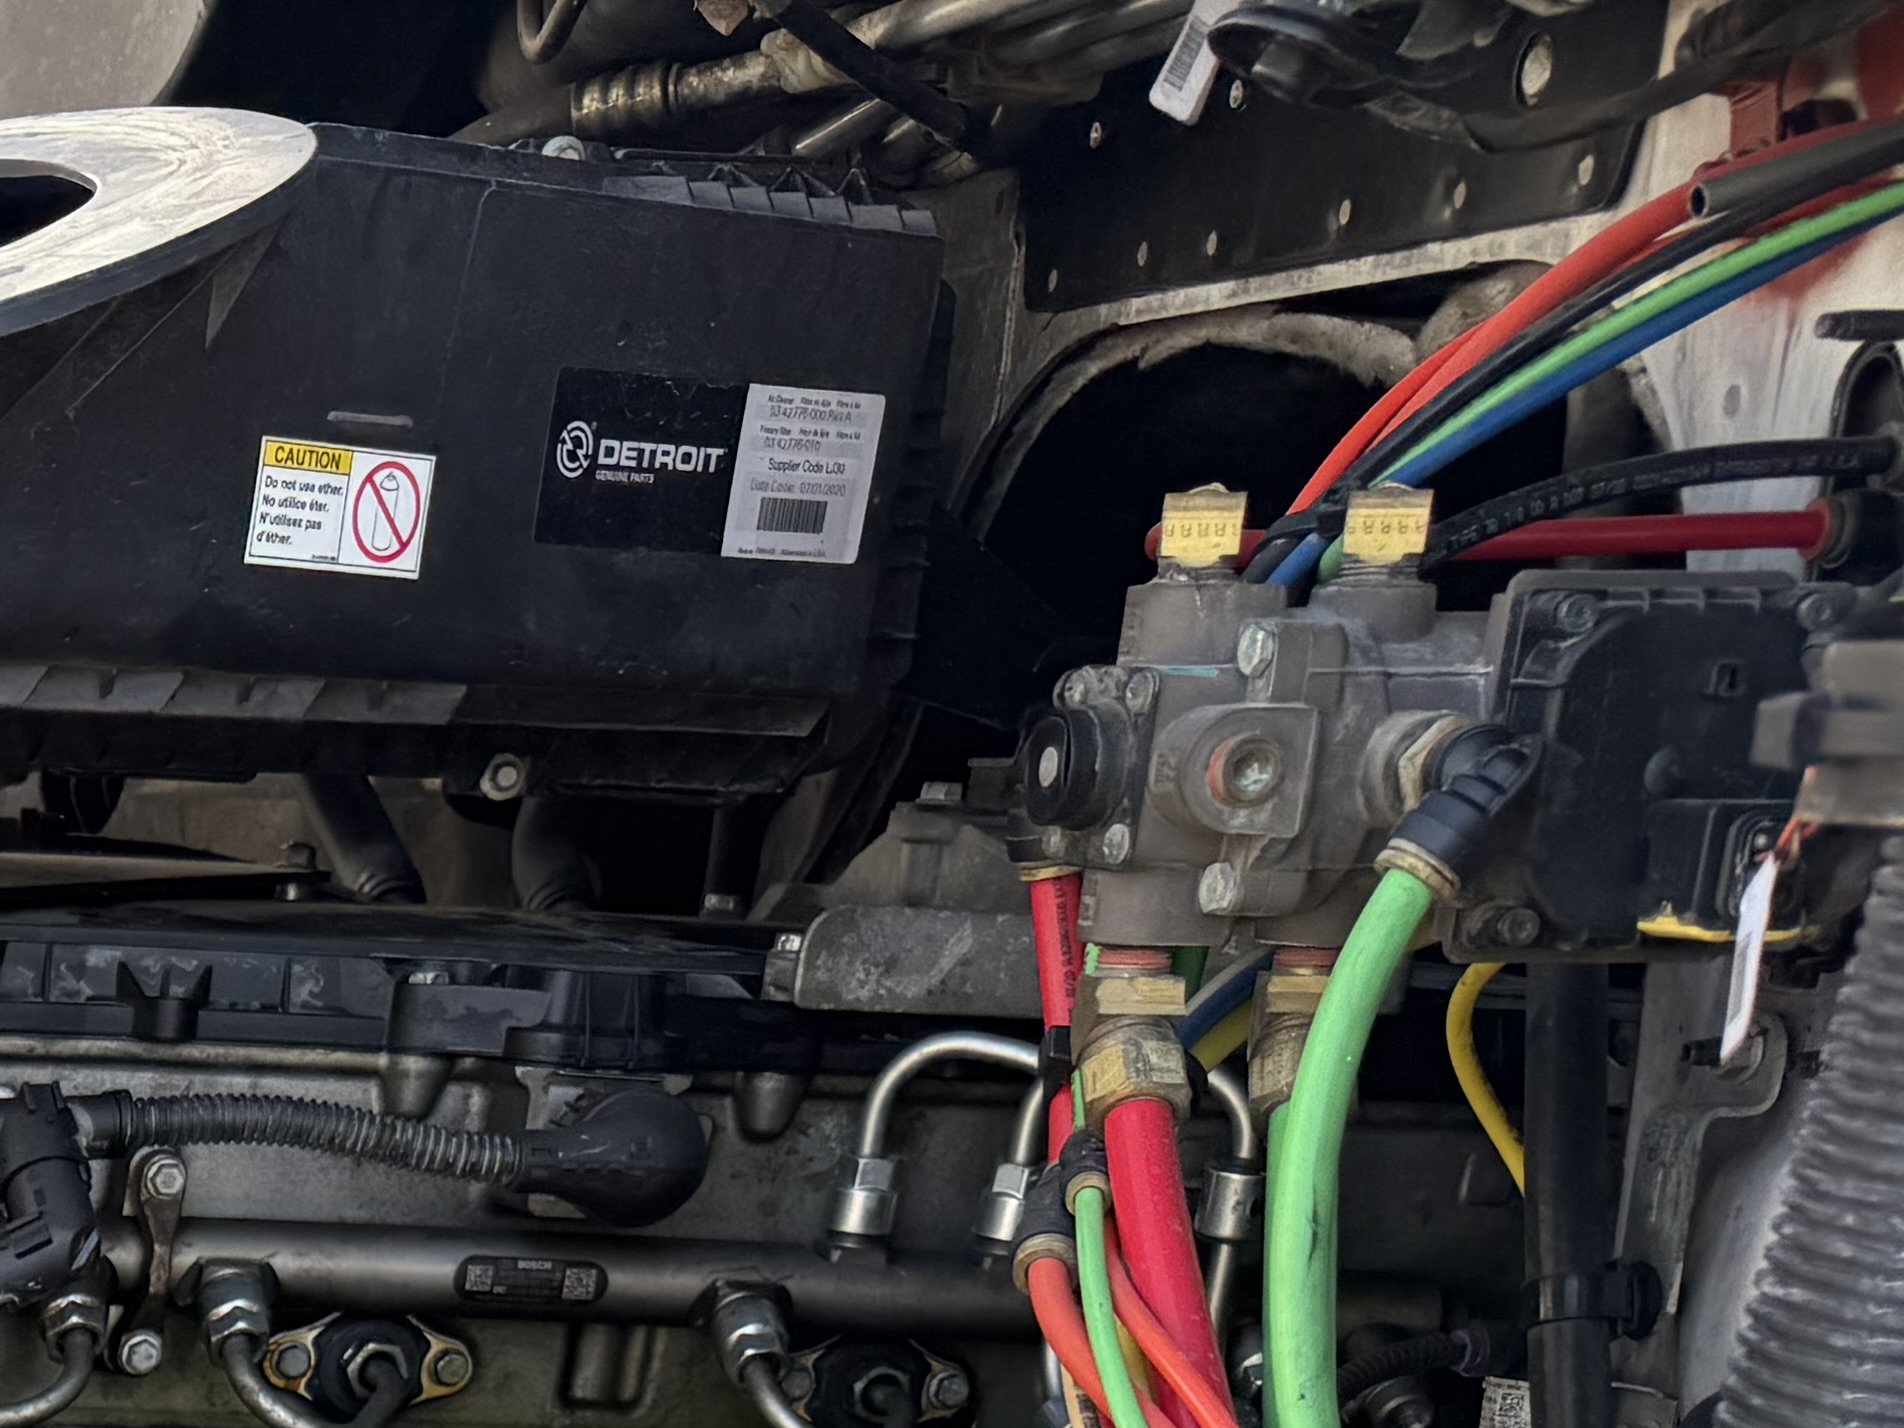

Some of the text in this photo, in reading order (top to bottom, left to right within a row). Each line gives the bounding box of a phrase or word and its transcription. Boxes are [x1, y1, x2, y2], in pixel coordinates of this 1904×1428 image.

[274, 445, 341, 470] CAUTION
[597, 439, 725, 473] DETROIT
[264, 475, 277, 488] Do
[281, 480, 296, 491] not
[299, 483, 316, 492] use
[262, 494, 275, 508] No
